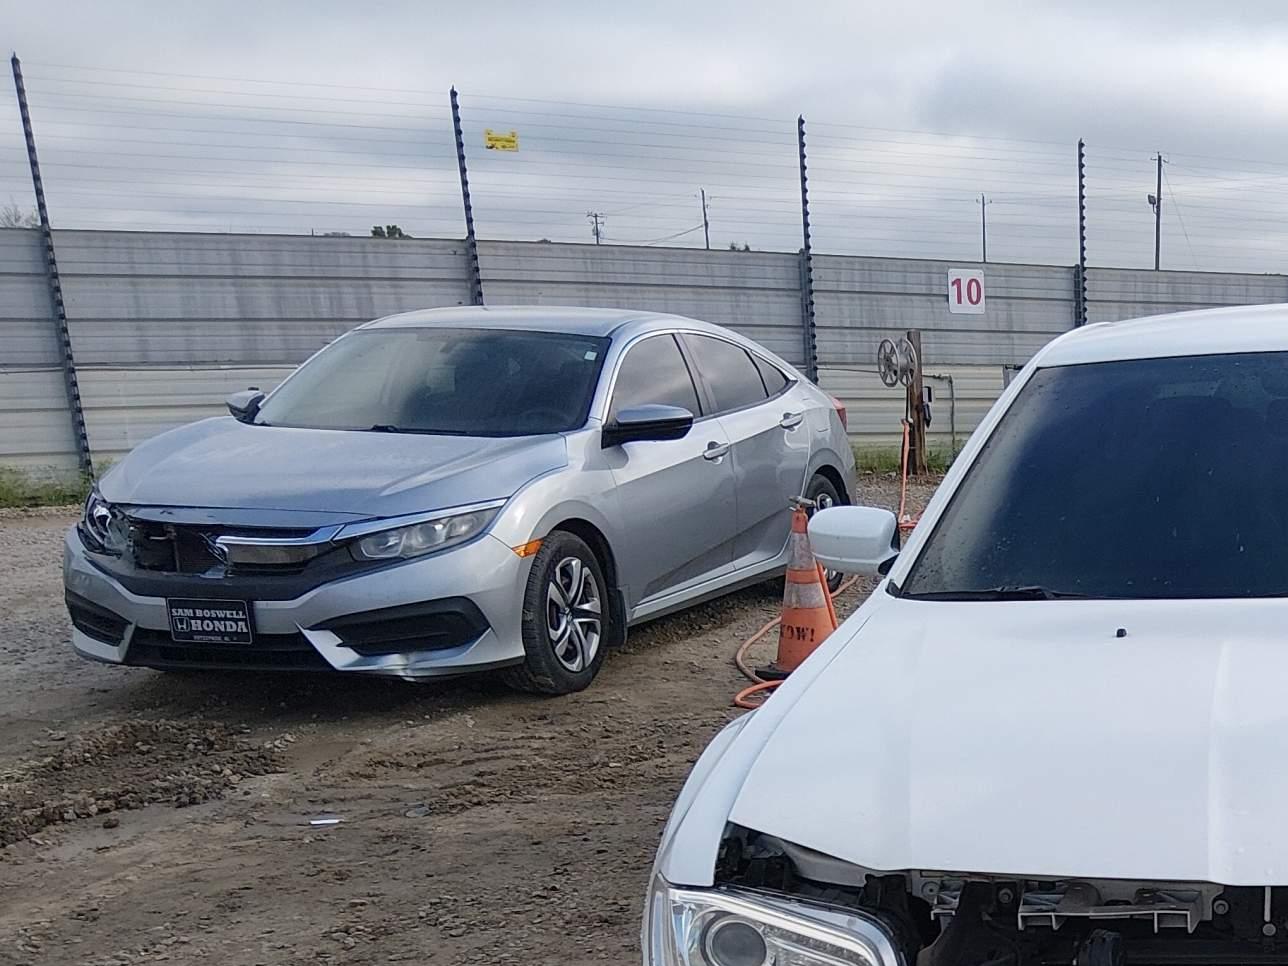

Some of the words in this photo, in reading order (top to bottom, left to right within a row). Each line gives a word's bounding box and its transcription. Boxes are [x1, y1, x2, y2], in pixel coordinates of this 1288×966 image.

[951, 278, 982, 305] 10
[172, 608, 194, 616] SAM
[196, 609, 246, 618] BOSWELL
[191, 619, 248, 632] HONDA
